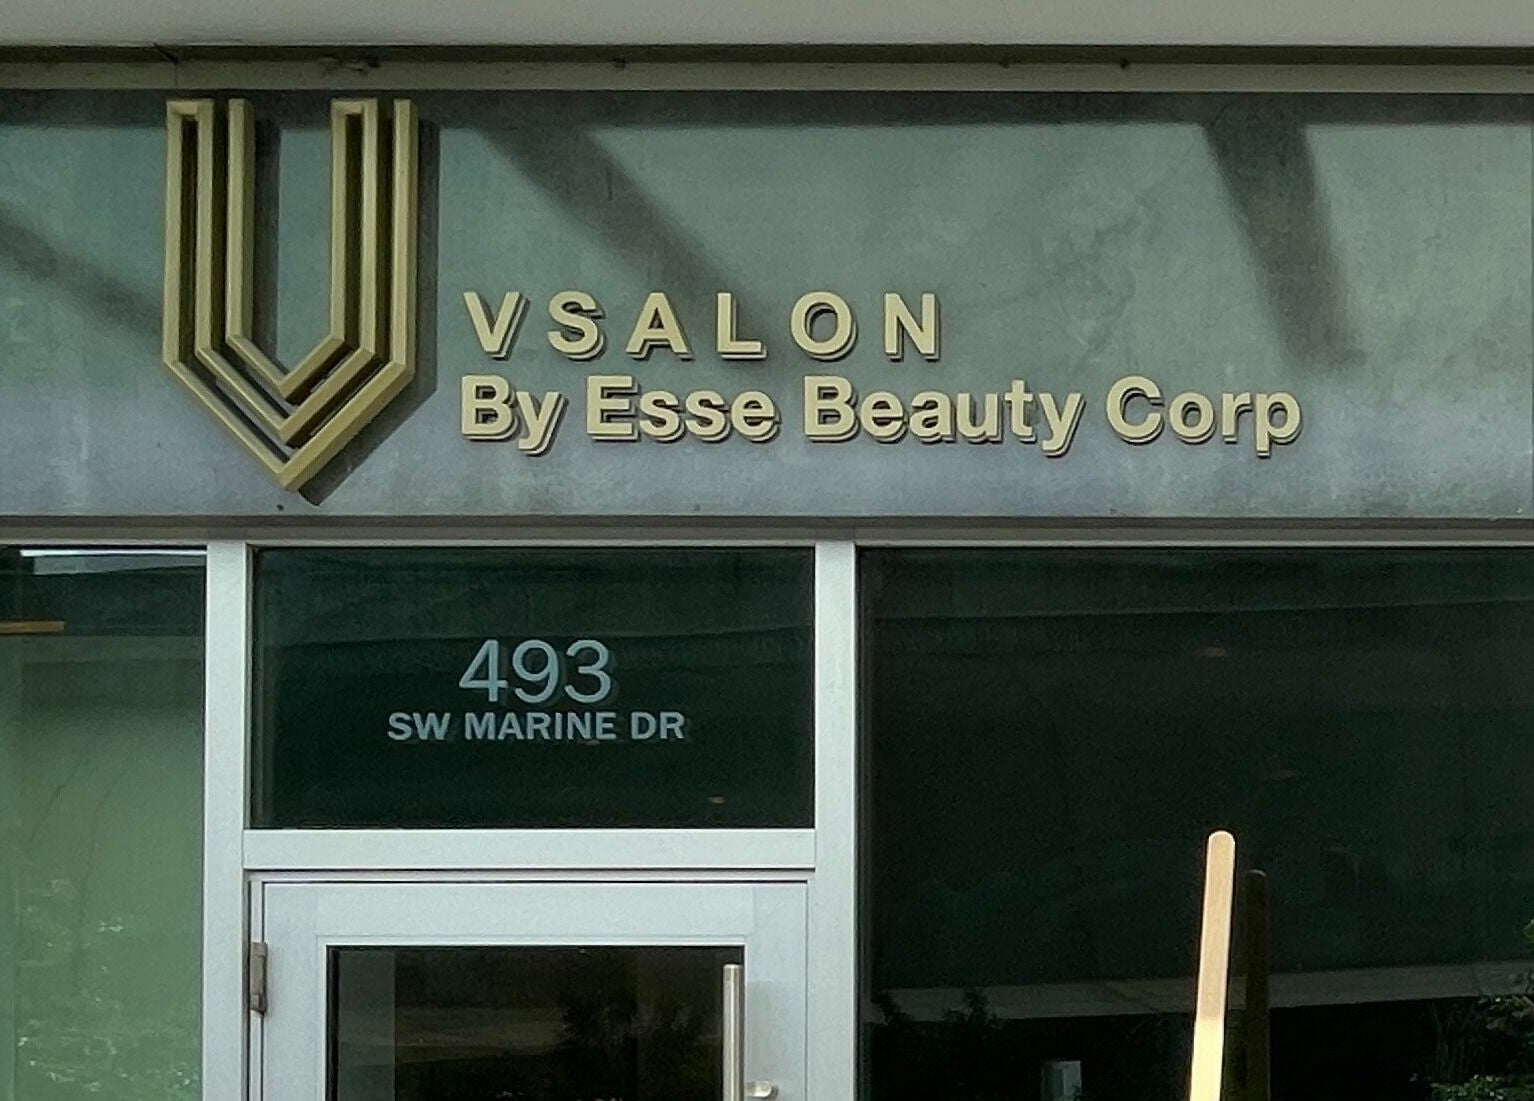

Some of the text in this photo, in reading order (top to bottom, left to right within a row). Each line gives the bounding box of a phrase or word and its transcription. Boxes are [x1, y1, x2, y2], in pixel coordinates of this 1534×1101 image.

[463, 291, 938, 361] VSALON
[461, 375, 1302, 456] By Esse Beauty Corp
[459, 639, 612, 704] 493
[387, 711, 686, 740] SW MARINE DR
